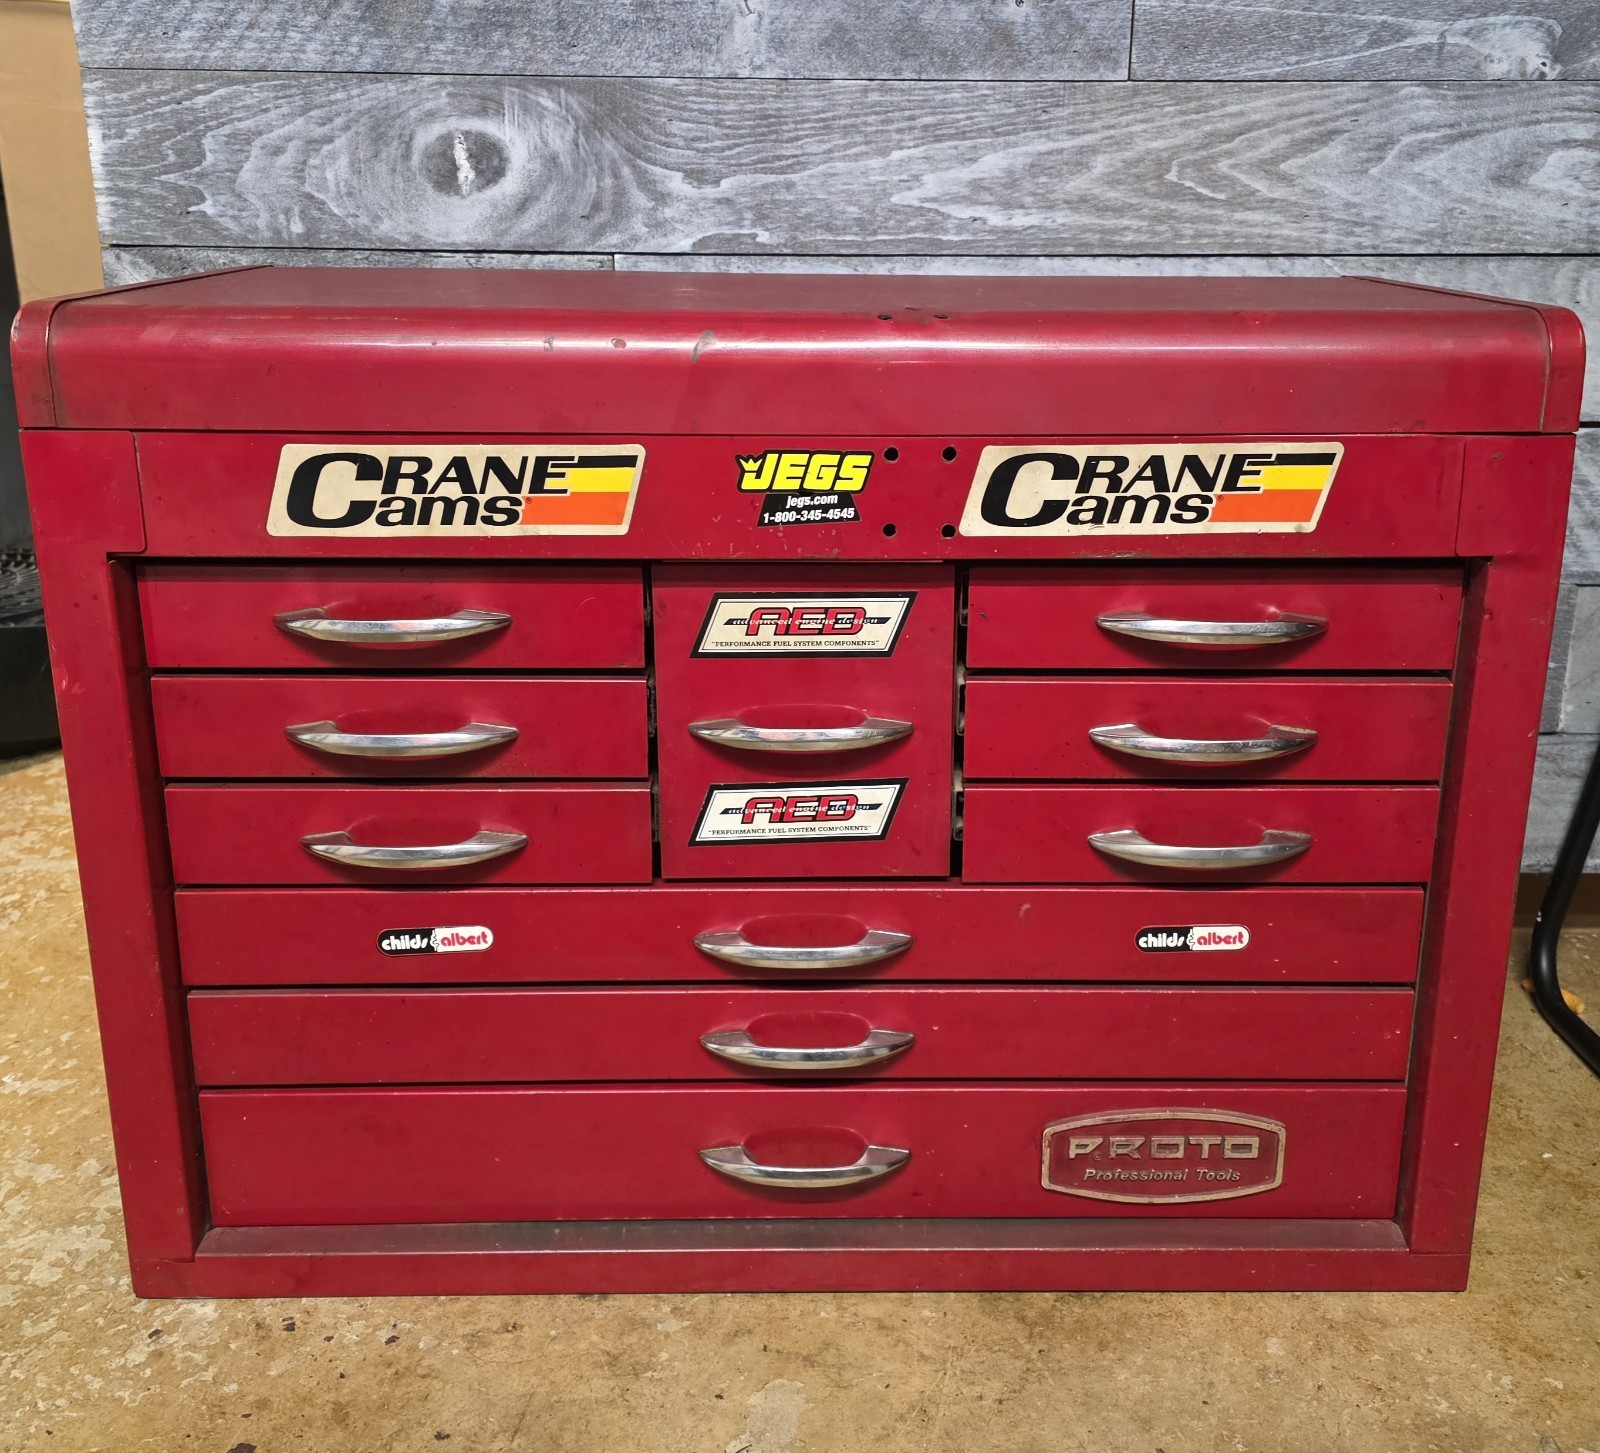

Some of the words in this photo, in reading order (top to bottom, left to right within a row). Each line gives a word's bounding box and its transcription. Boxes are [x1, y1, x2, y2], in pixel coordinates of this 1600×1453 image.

[741, 453, 872, 491] JEGS
[287, 452, 575, 528] CRANE
[981, 452, 1272, 528] CRANE
[786, 494, 839, 508] jegs.com
[763, 507, 855, 523] 1-800-345-4545
[732, 617, 792, 626] advanced
[794, 617, 836, 626] engine
[837, 616, 879, 626] design
[745, 606, 867, 637] AED
[728, 805, 786, 815] advanced
[788, 805, 829, 814] engine
[830, 803, 871, 812] design
[740, 794, 859, 825] AED
[787, 826, 817, 834] SYSTEM
[381, 934, 429, 951] childs
[440, 931, 489, 947] albert
[1138, 932, 1186, 948] childs
[1196, 931, 1245, 946] albert
[1069, 1136, 1260, 1159] PROTO
[1083, 1168, 1189, 1182] Professional
[1196, 1168, 1241, 1182] Tools
